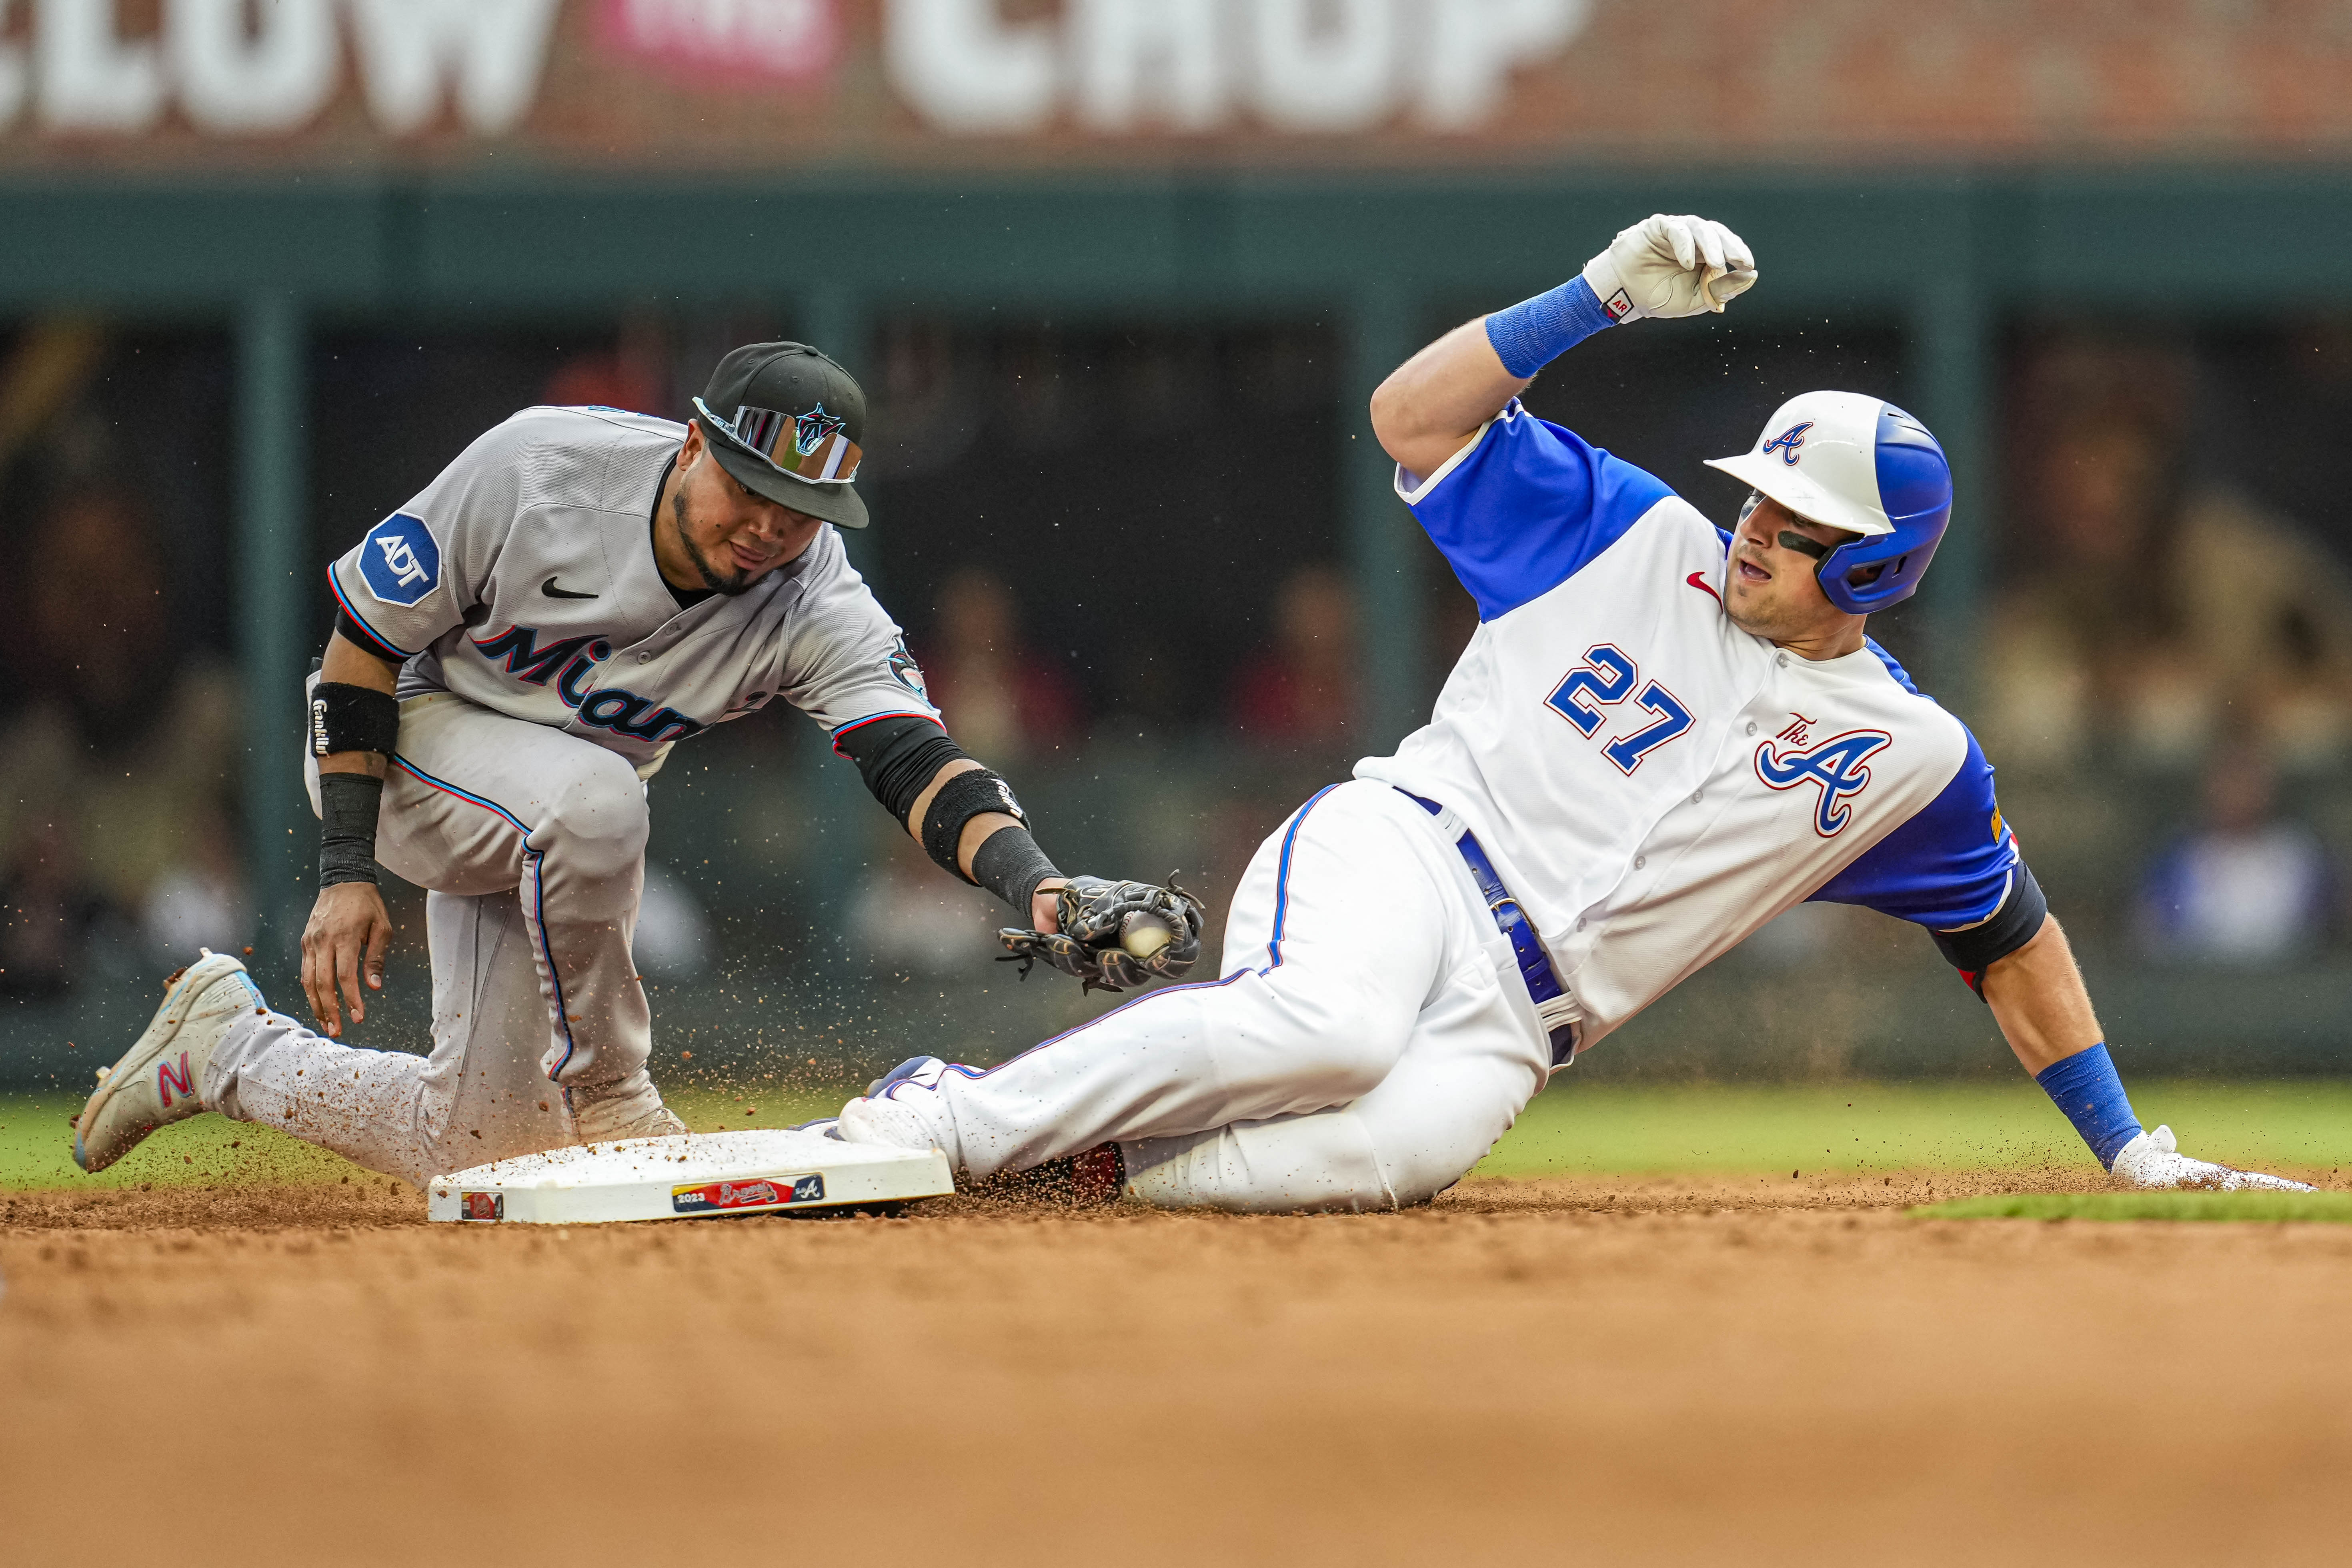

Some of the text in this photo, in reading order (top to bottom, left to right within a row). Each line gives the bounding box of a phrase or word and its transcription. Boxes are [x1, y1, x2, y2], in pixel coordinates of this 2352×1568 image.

[1613, 300, 1627, 312] AR
[1762, 422, 1814, 466] A
[375, 535, 429, 587] ADT
[1543, 643, 1695, 777] 27
[1776, 712, 1818, 747] The
[1755, 729, 1892, 838] A
[157, 1050, 194, 1107] N
[677, 1193, 705, 1204] 2023
